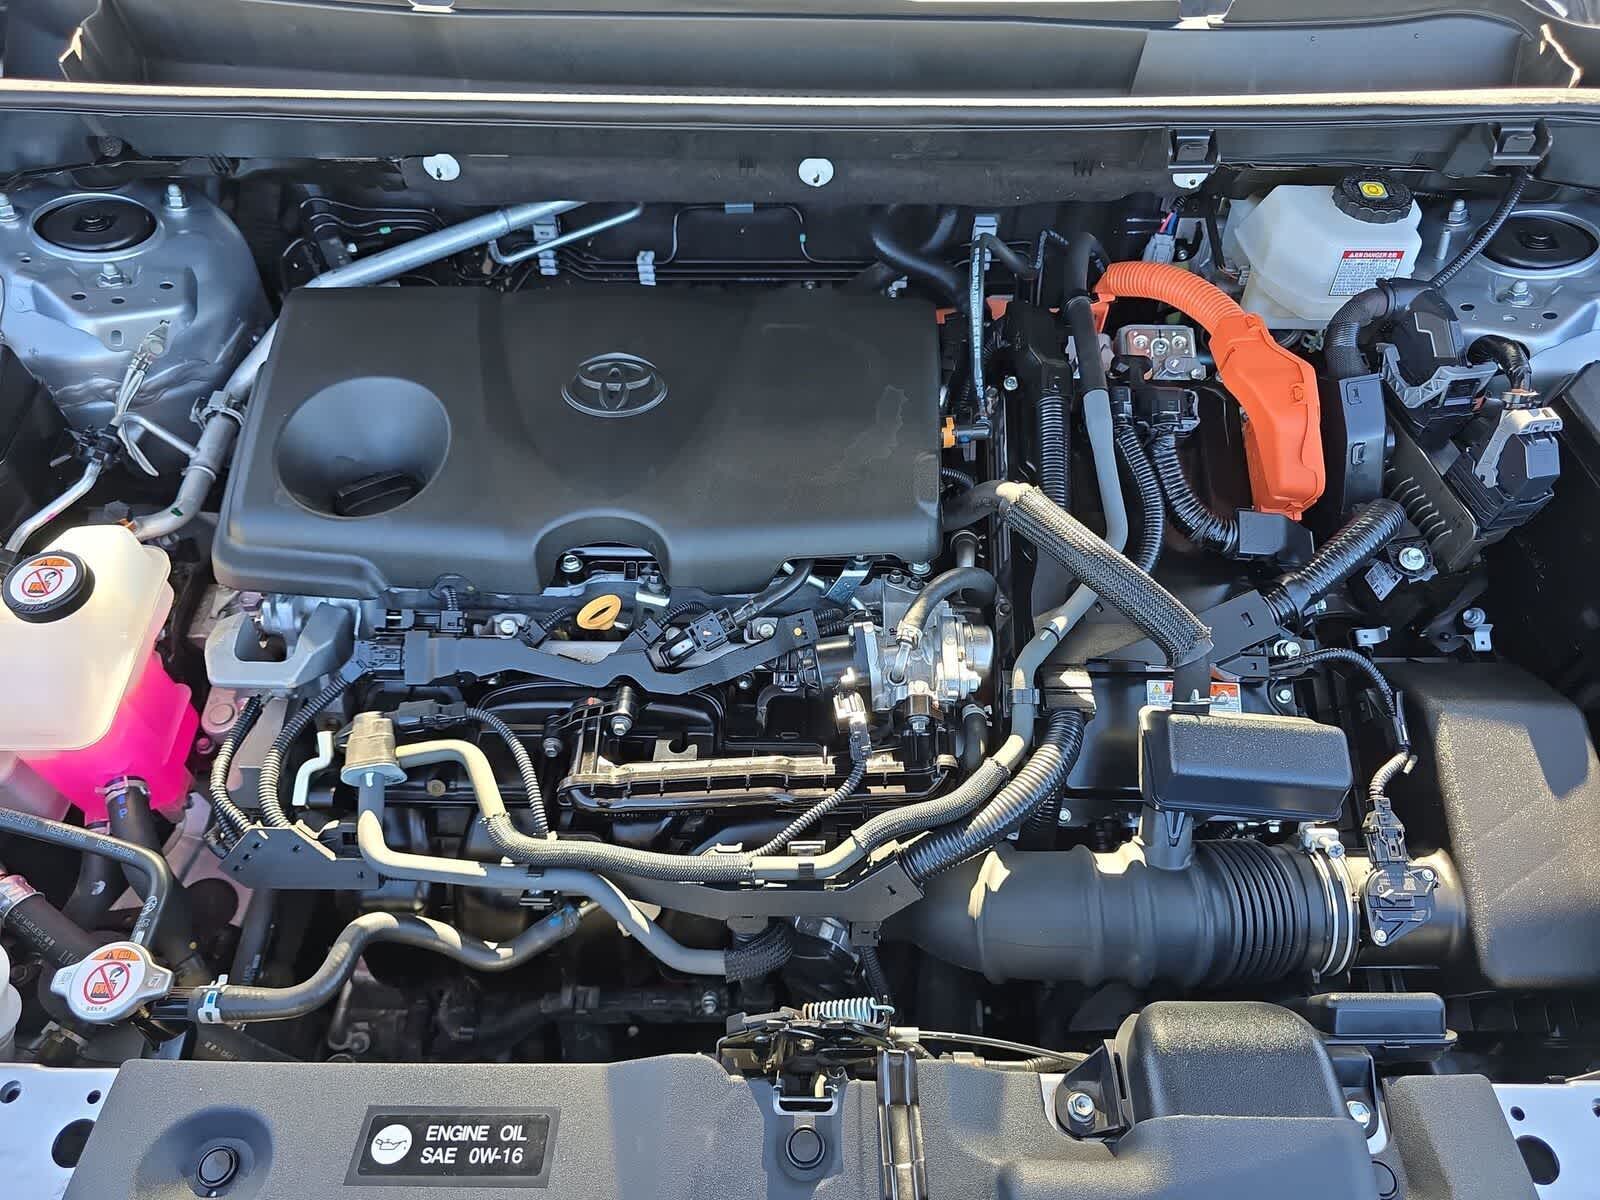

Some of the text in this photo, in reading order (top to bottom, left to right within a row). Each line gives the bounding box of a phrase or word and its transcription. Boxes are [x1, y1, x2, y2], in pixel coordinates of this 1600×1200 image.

[425, 1125, 528, 1141] ENGINE OIL
[420, 1147, 524, 1165] SAE 0W-16
